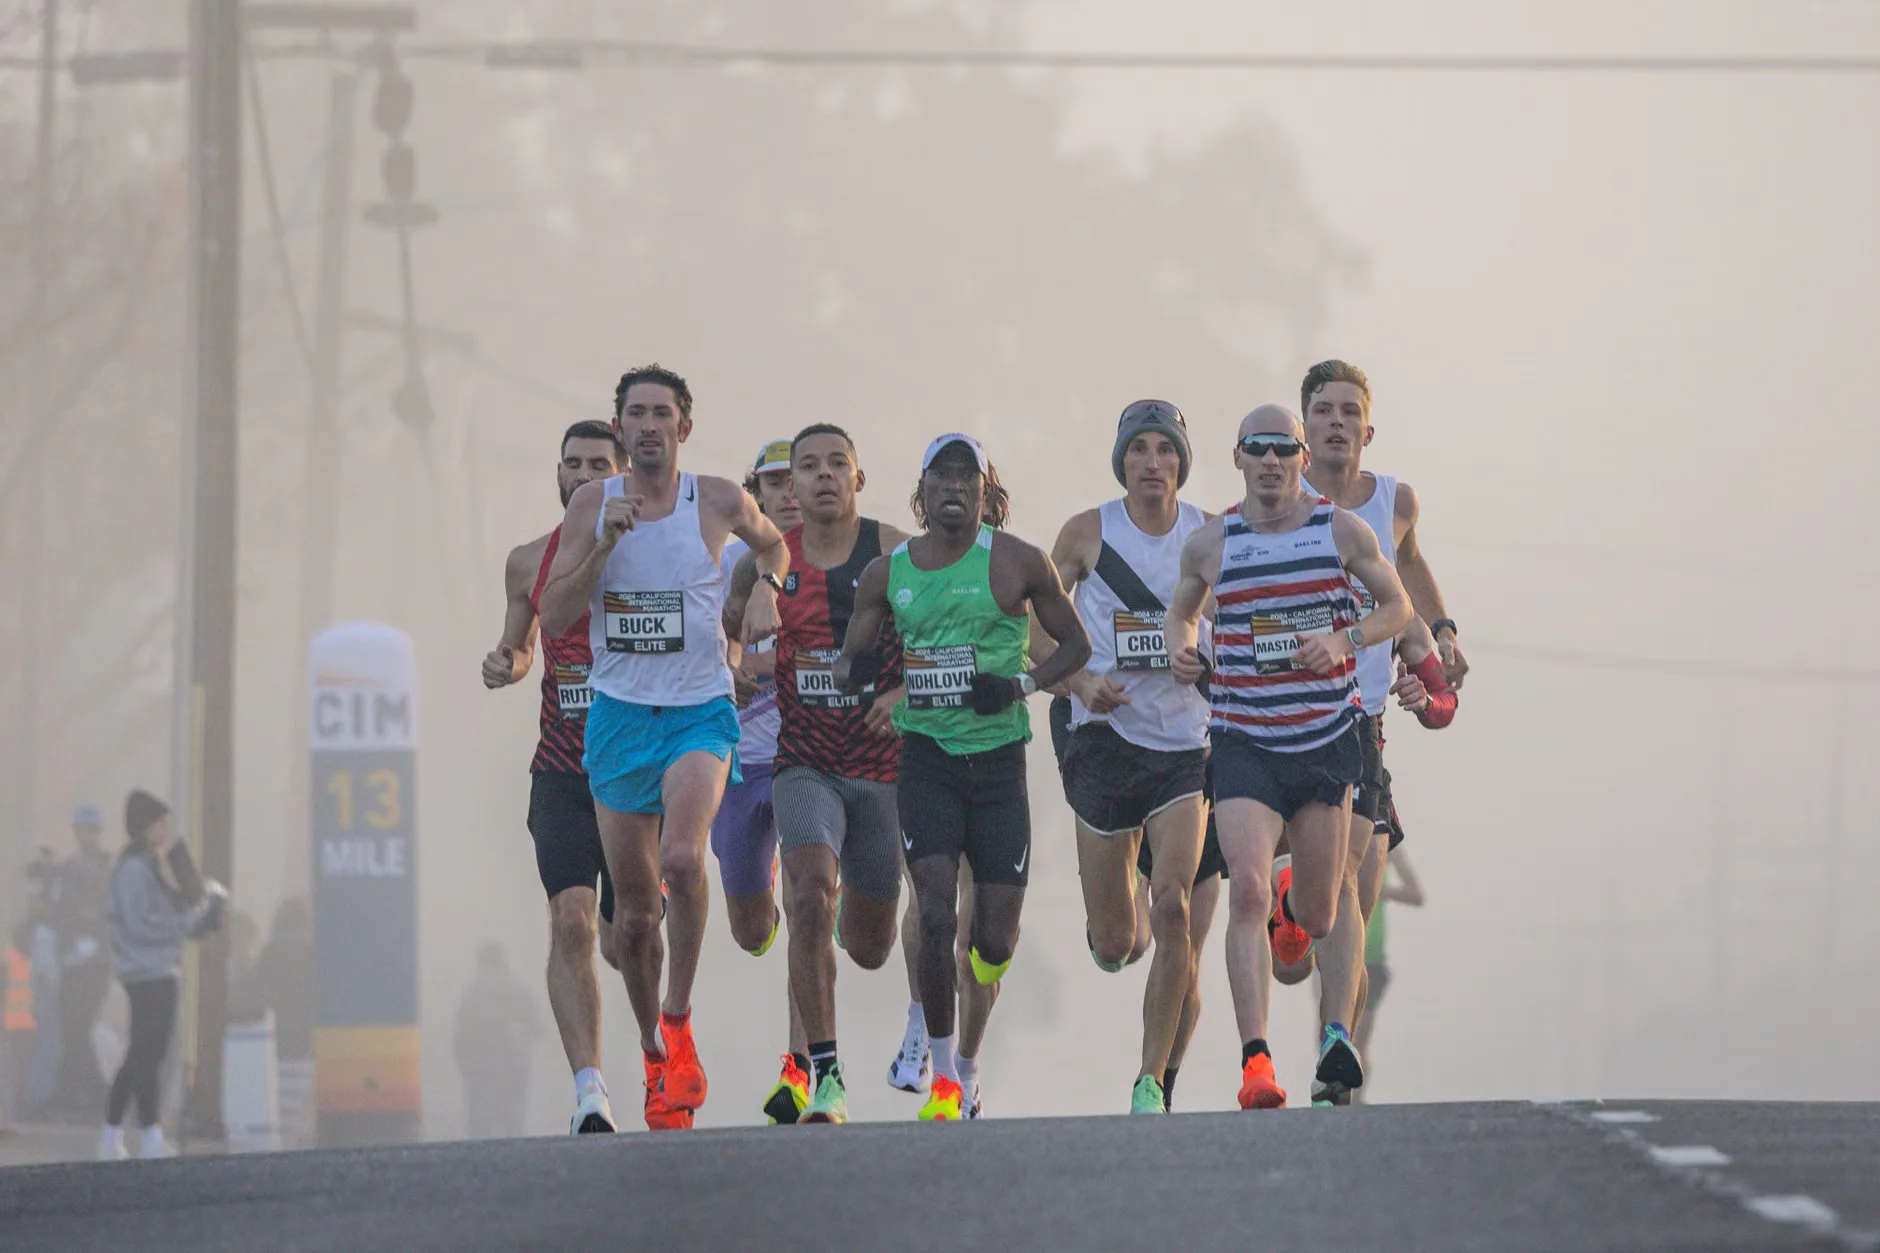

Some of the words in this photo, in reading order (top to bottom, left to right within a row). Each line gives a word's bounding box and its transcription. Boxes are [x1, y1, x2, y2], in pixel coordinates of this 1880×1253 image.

[1293, 606, 1331, 617] CALIFORNIA
[1281, 612, 1330, 625] INTERNATIONAL
[1296, 619, 1332, 629] MARATHON
[619, 617, 666, 634] BUCK
[634, 640, 666, 651] ELITE
[1128, 635, 1166, 652] CRO
[935, 645, 973, 654] CALIFORNIA
[925, 652, 973, 661] INTERNATIONAL
[937, 658, 974, 666] MARATHON
[1151, 657, 1171, 668] ELI
[828, 695, 859, 707] ELITE
[932, 695, 962, 706] ELITE
[316, 693, 409, 738] CIM
[327, 769, 402, 830] 13
[323, 837, 406, 878] MILE
